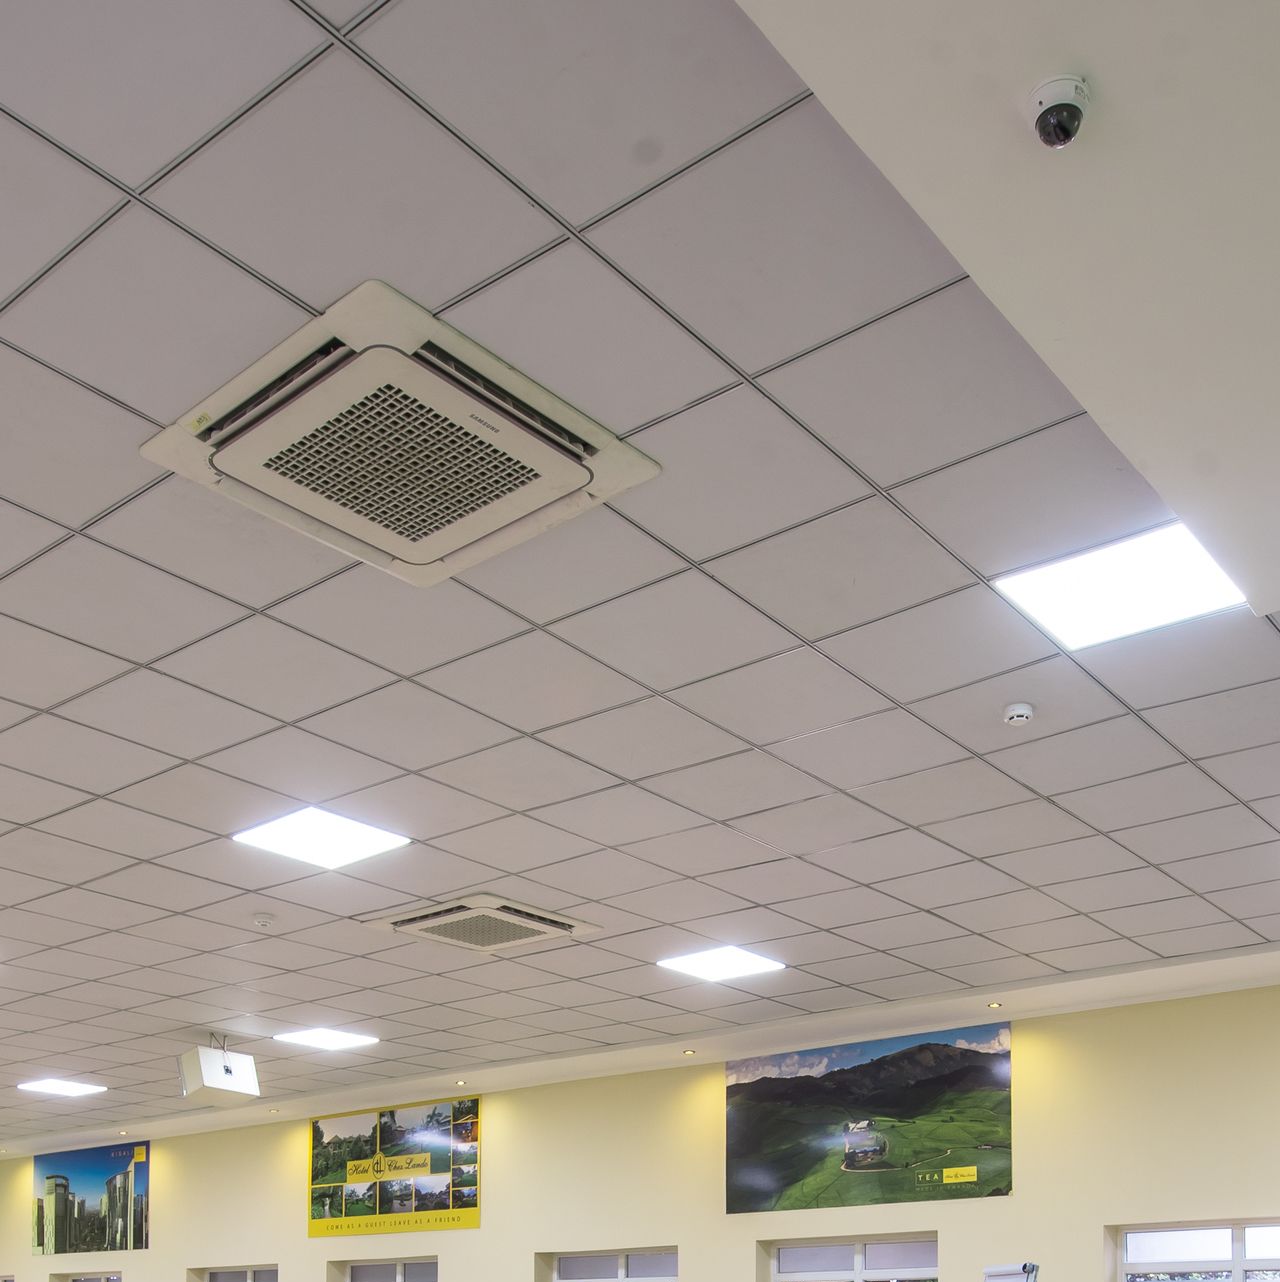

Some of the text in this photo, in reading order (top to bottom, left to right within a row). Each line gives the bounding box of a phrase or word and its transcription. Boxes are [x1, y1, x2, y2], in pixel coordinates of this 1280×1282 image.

[470, 414, 500, 433] SAMSUNG
[348, 1164, 371, 1175] Hotel
[387, 1159, 403, 1172] Chez
[405, 1157, 429, 1170] Lando
[918, 1173, 939, 1181] TEA
[365, 1221, 386, 1229] GUEST
[390, 1219, 410, 1227] LEAVE
[434, 1216, 461, 1224] FRIEND
